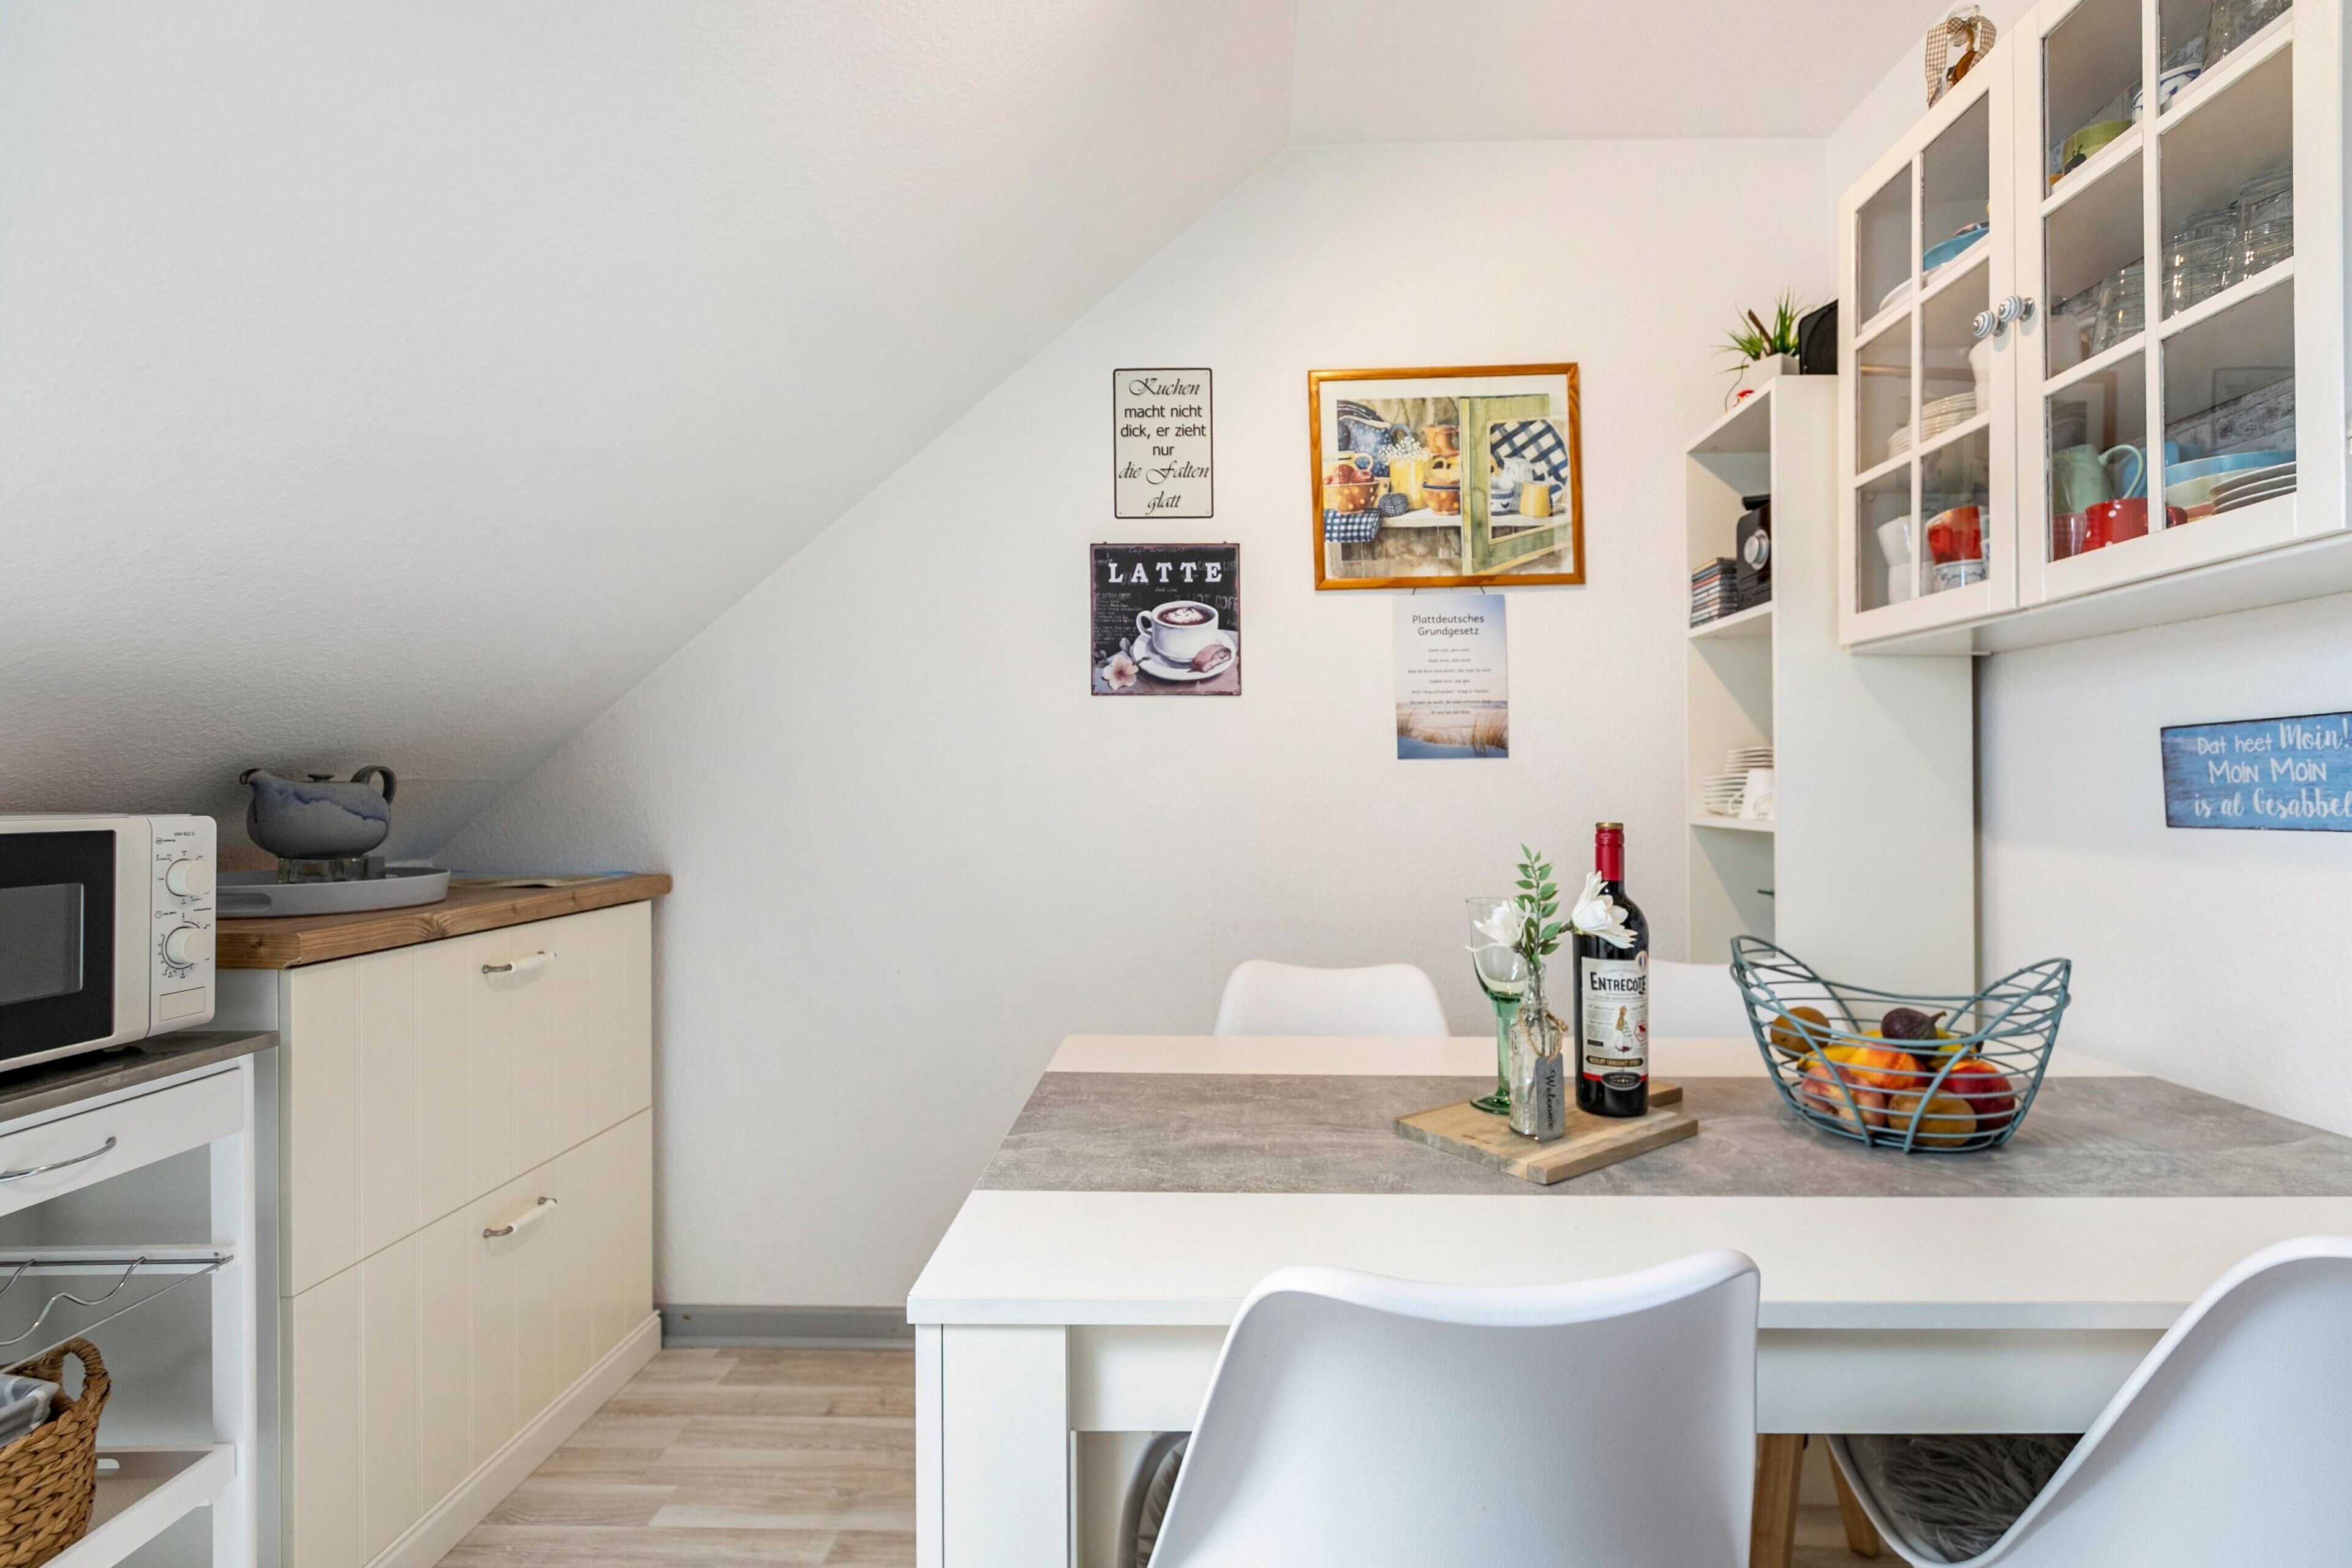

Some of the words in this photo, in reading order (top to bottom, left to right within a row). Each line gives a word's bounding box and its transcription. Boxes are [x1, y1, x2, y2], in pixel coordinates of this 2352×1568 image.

[1129, 378, 1200, 396] Kuchen
[1125, 405, 1166, 418] macht
[1170, 404, 1202, 418] nicht
[1120, 424, 1151, 439] dick,
[1156, 426, 1170, 437] er
[1175, 424, 1207, 437] zieht
[1153, 445, 1175, 456] nur
[1118, 461, 1142, 478] die
[1146, 460, 1210, 484] Falten
[1145, 491, 1182, 515] glatt
[1108, 562, 1223, 583] LATTE
[1412, 614, 1485, 624] Plattdeutsches
[1418, 626, 1480, 638] Grundgesetz
[2197, 736, 2226, 755] Dat
[2235, 733, 2274, 753] heet
[2279, 717, 2349, 750] Moin!
[2195, 793, 2212, 818] is
[2220, 791, 2245, 817] al
[1545, 1069, 1556, 1131] Welcome
